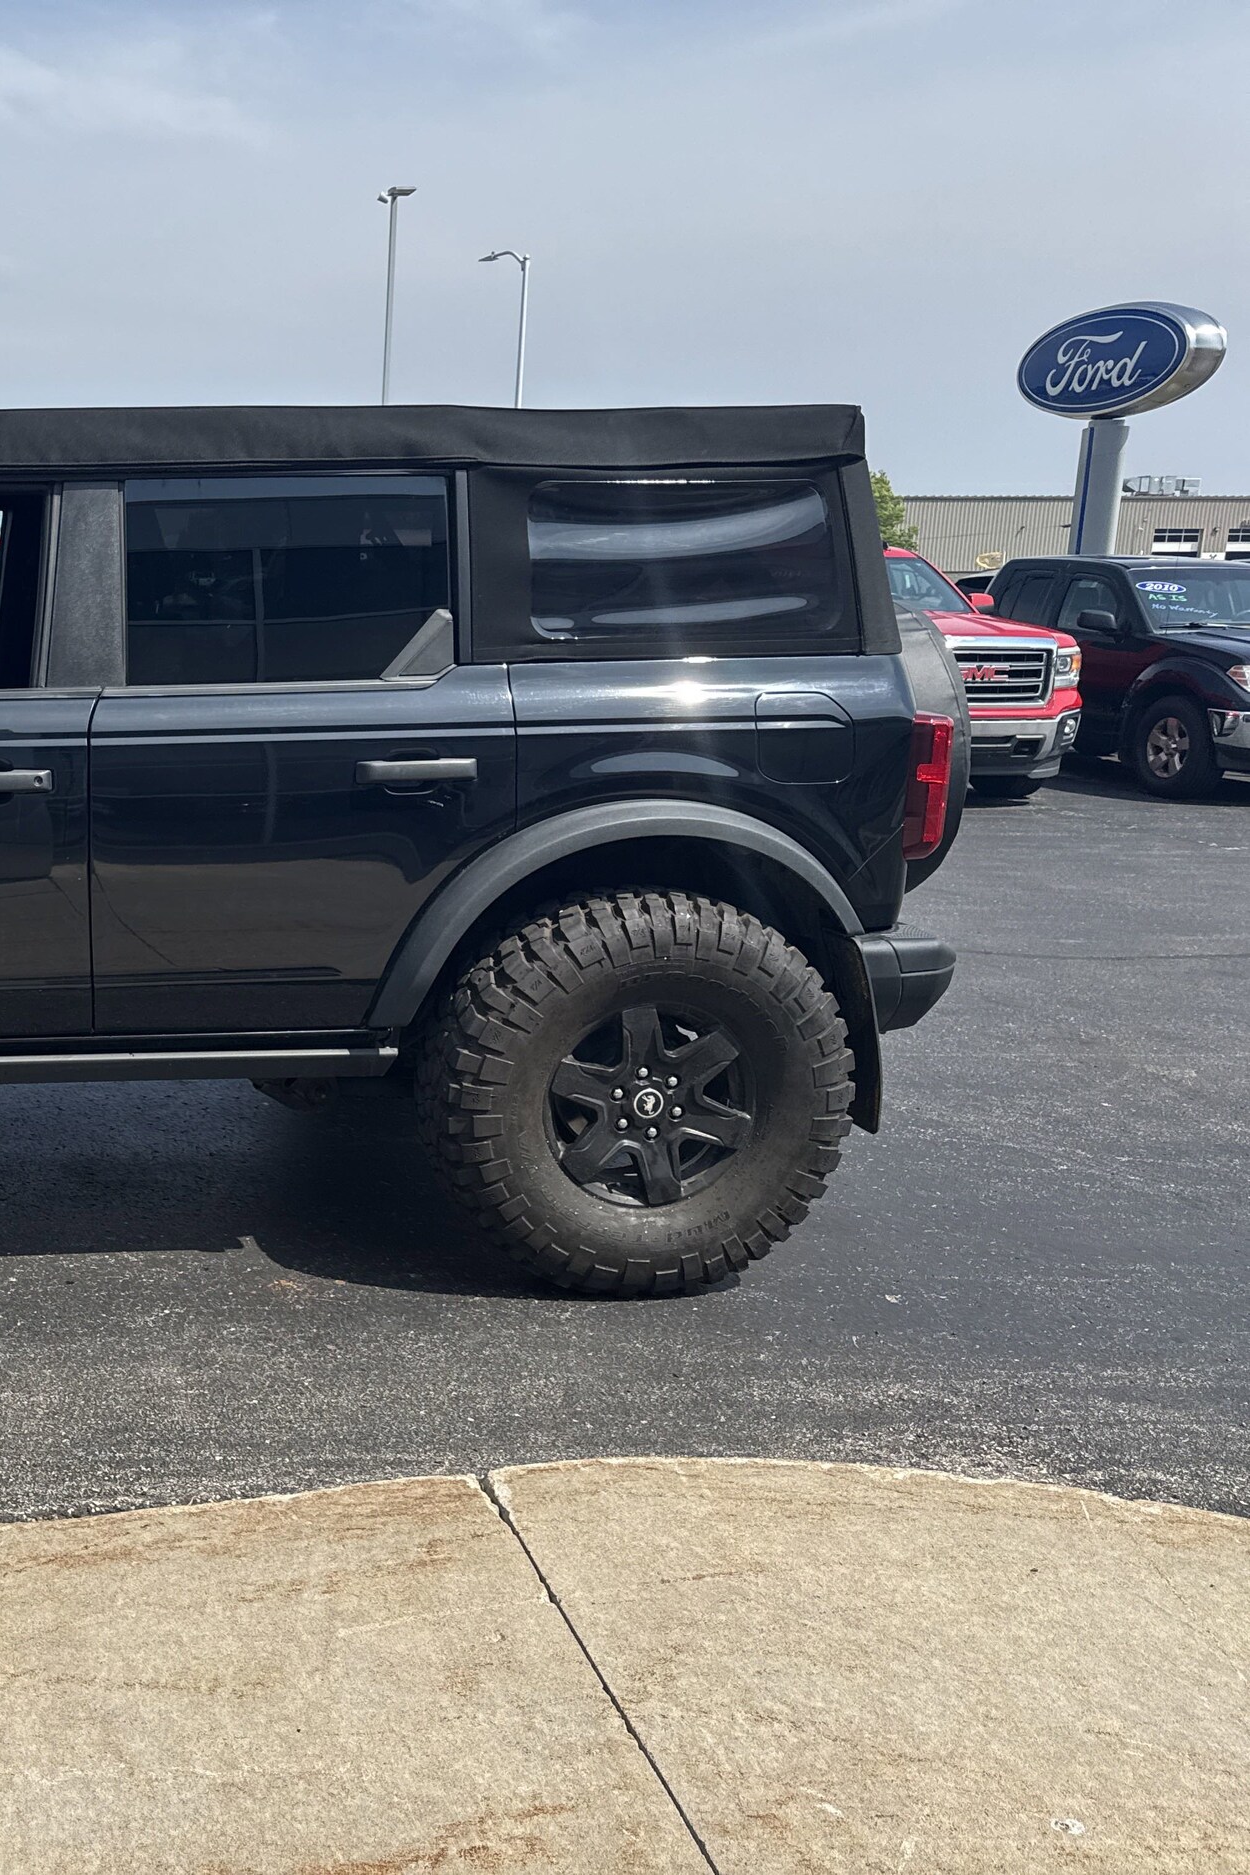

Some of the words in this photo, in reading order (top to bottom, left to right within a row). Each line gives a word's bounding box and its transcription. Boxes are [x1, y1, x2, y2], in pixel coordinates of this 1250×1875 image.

[1045, 331, 1148, 396] Ford
[1145, 583, 1179, 592] 2010
[1148, 593, 1166, 601] AS
[1169, 594, 1188, 602] IS
